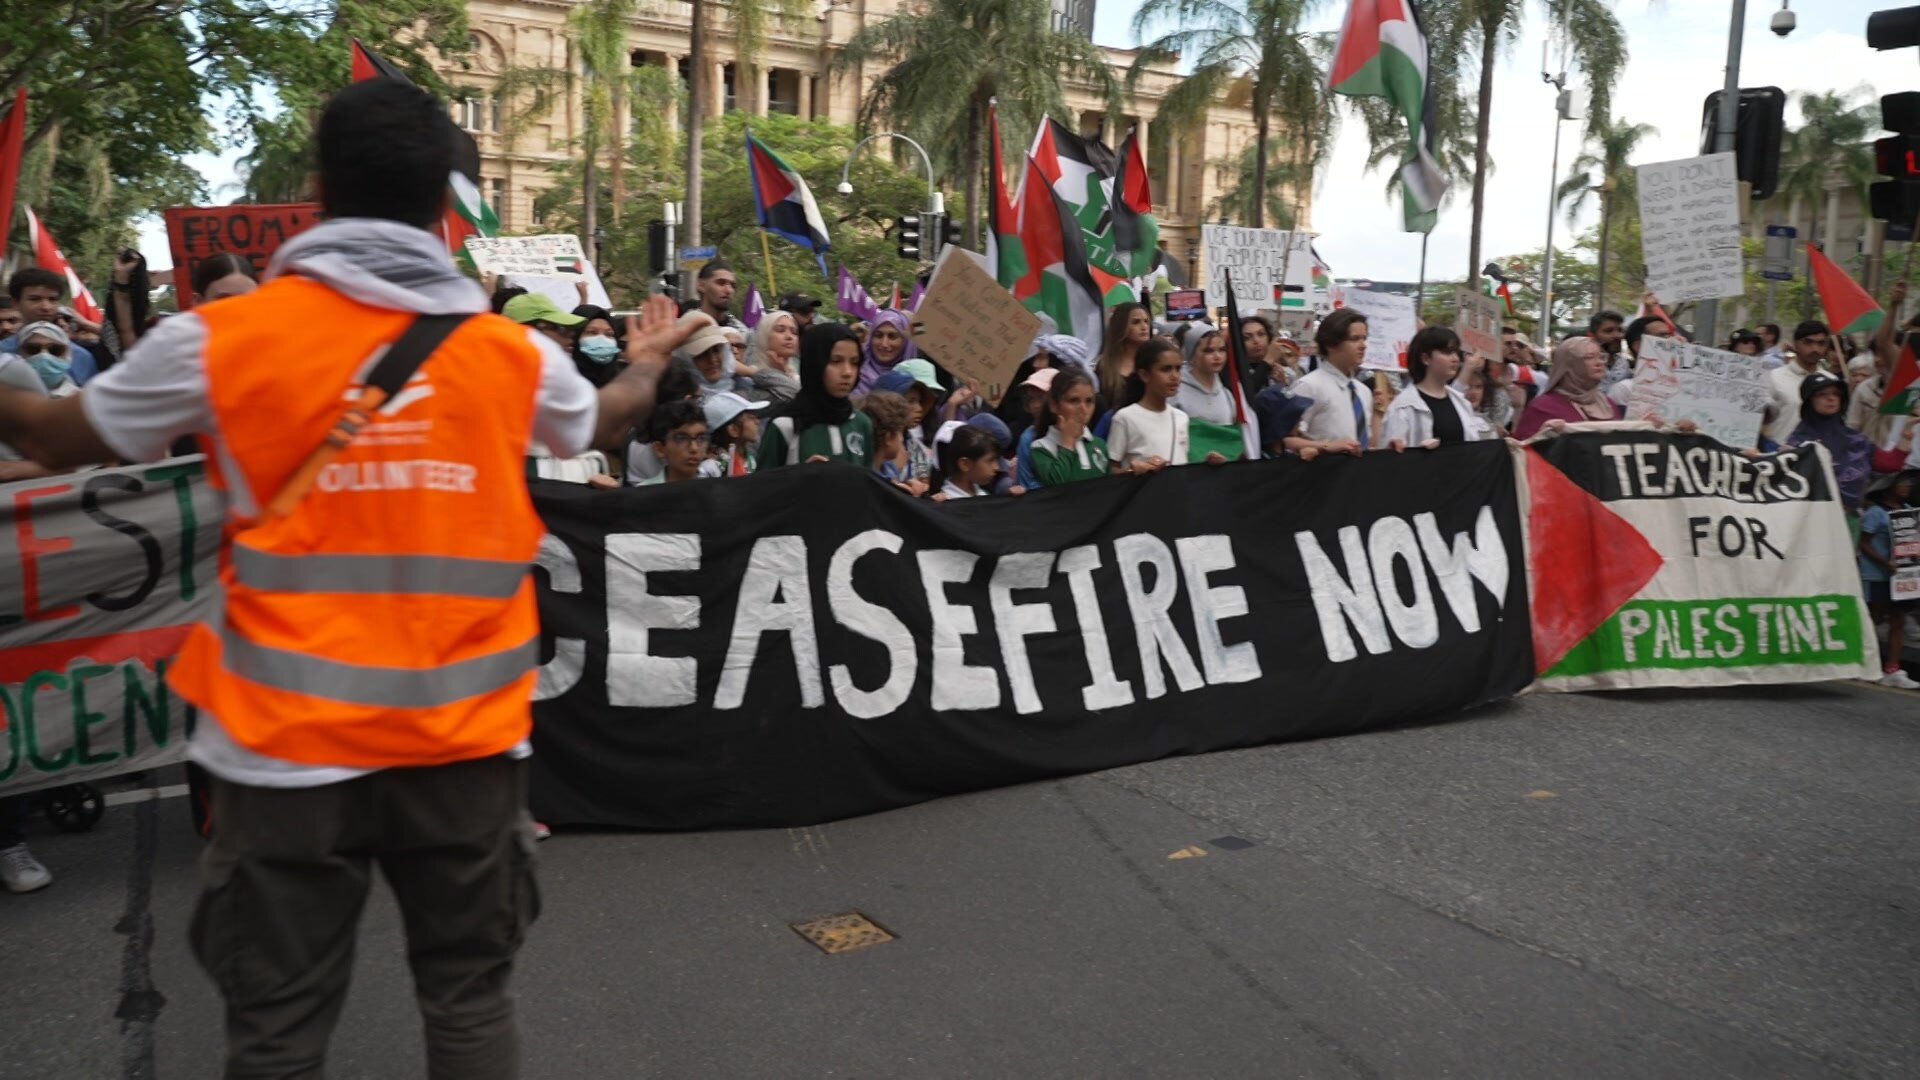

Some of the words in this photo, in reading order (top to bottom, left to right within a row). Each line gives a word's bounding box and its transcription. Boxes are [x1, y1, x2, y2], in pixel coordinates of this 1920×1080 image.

[183, 214, 286, 253] FROM
[316, 459, 478, 493] OLUNTEER
[1601, 443, 1810, 501] TEACHERS
[0, 465, 207, 626] EST
[1689, 515, 1785, 560] FOR
[532, 529, 1262, 719] CEASEFIRE
[1294, 505, 1509, 662] NOW
[1619, 601, 1848, 663] PALESTINE
